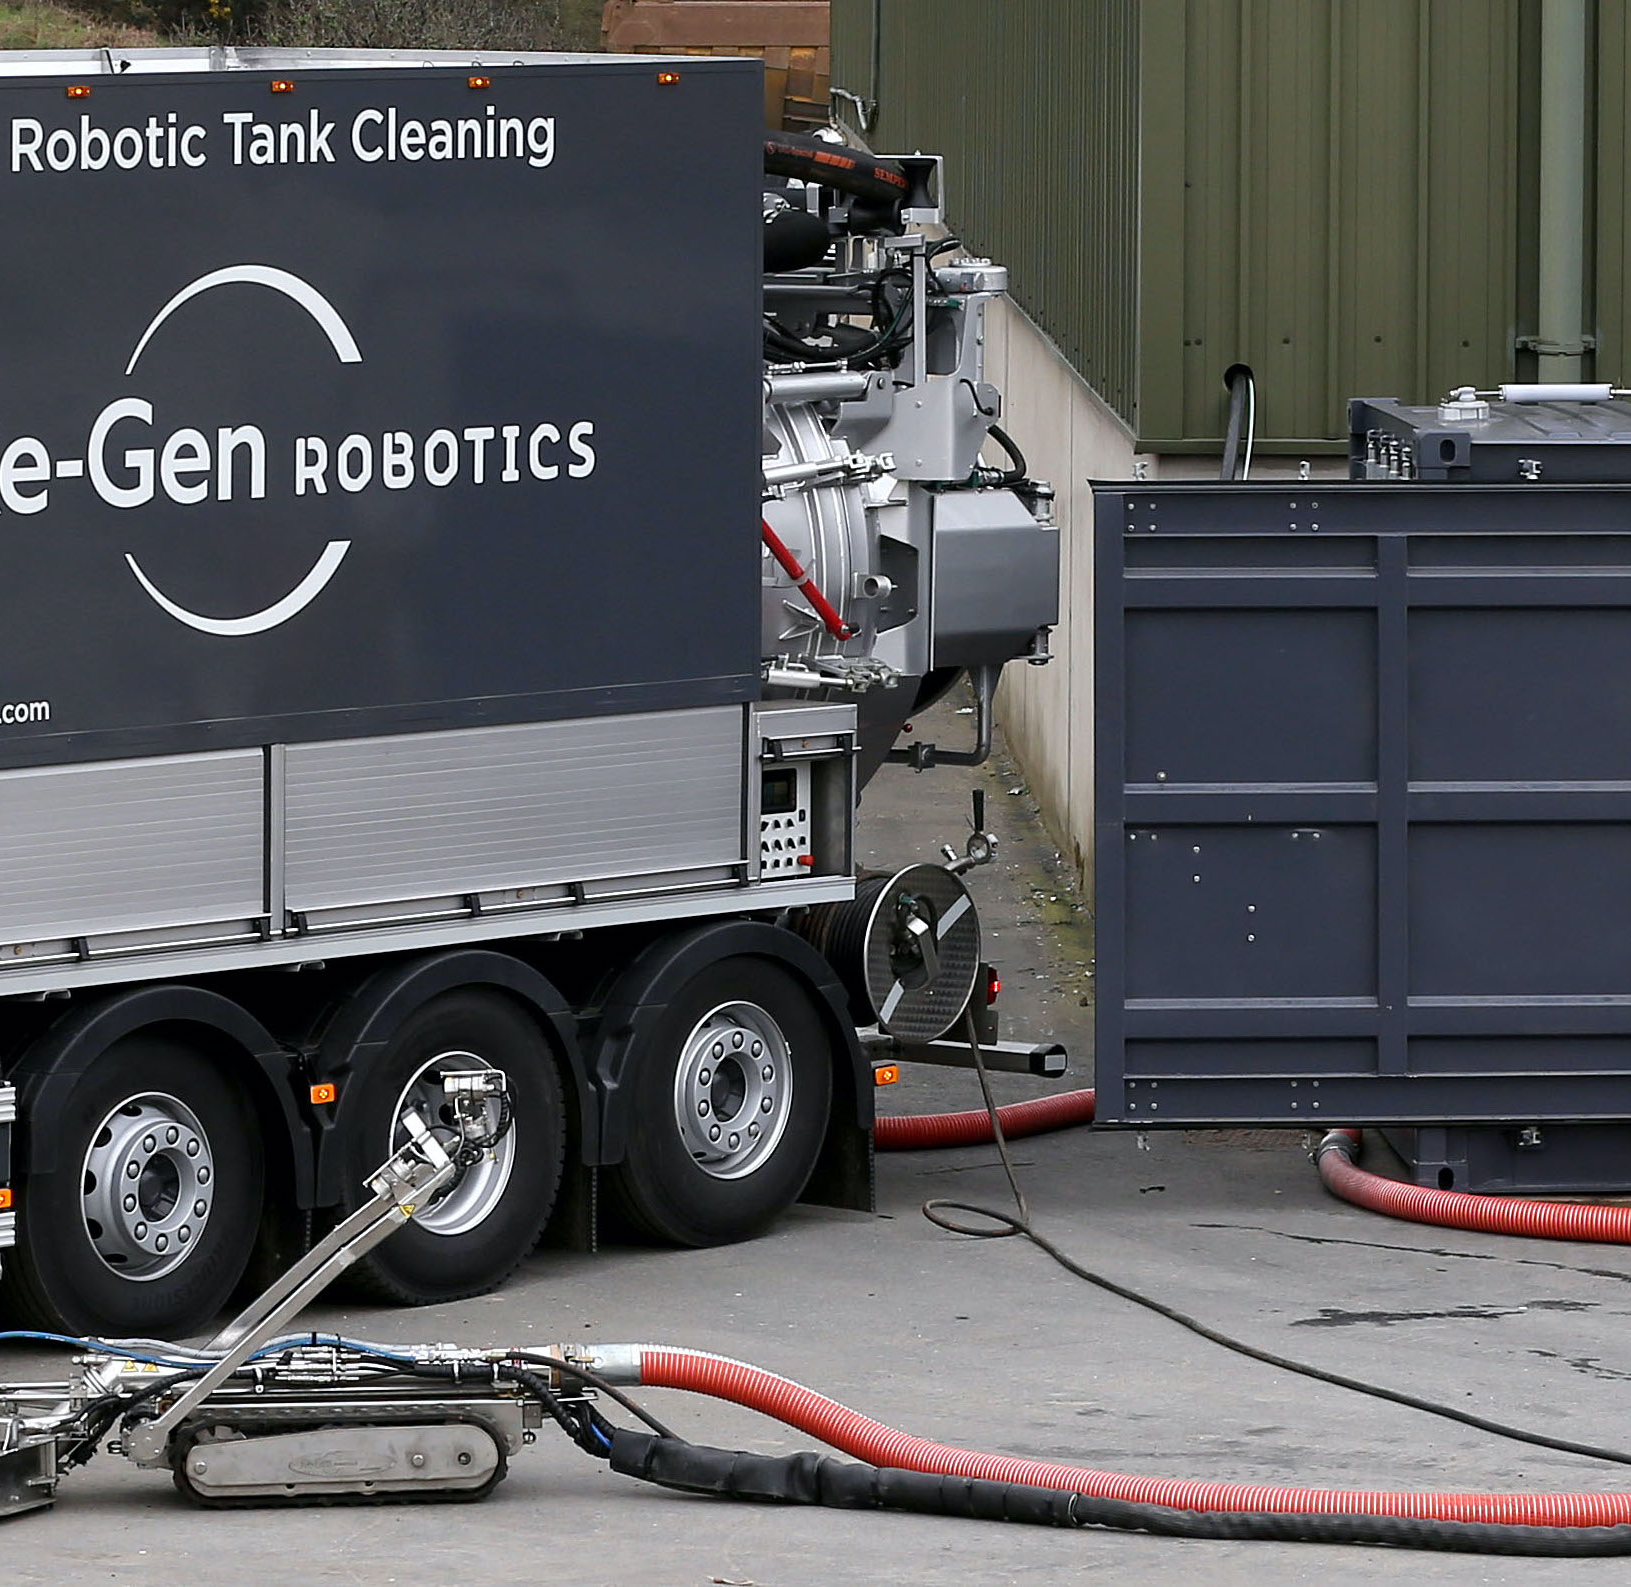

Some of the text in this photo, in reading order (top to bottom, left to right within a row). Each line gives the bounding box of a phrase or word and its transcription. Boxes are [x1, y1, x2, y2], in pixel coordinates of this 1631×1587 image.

[11, 105, 556, 172] Robotic Tank Cleaning
[295, 421, 596, 496] ROBOTICS
